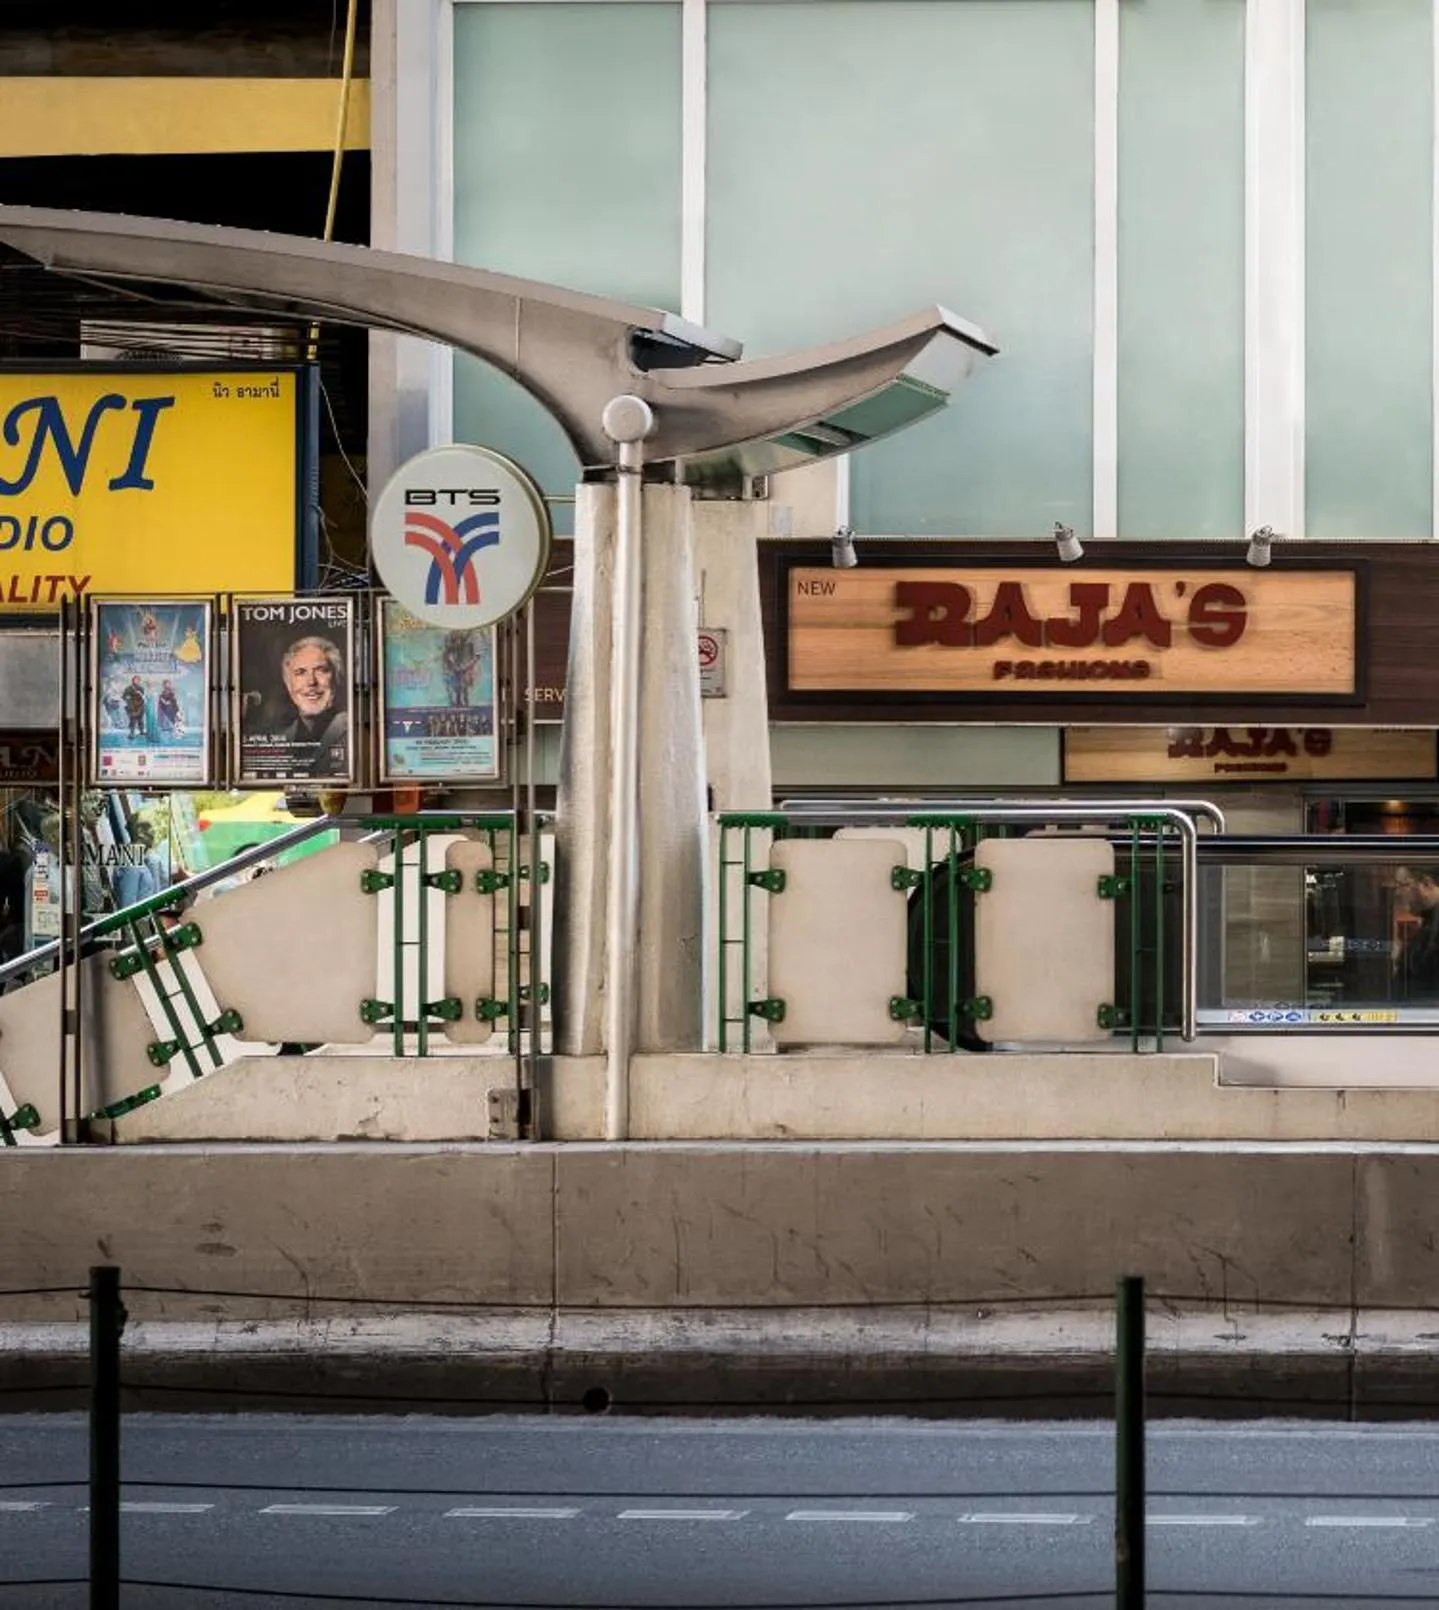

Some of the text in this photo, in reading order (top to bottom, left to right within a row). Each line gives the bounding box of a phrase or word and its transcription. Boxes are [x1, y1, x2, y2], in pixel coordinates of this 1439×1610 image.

[405, 489, 500, 505] BTS
[0, 575, 92, 603] LITY
[797, 581, 836, 597] NEW
[242, 606, 347, 624] TOM JONES
[894, 580, 1249, 650] RAJA'S
